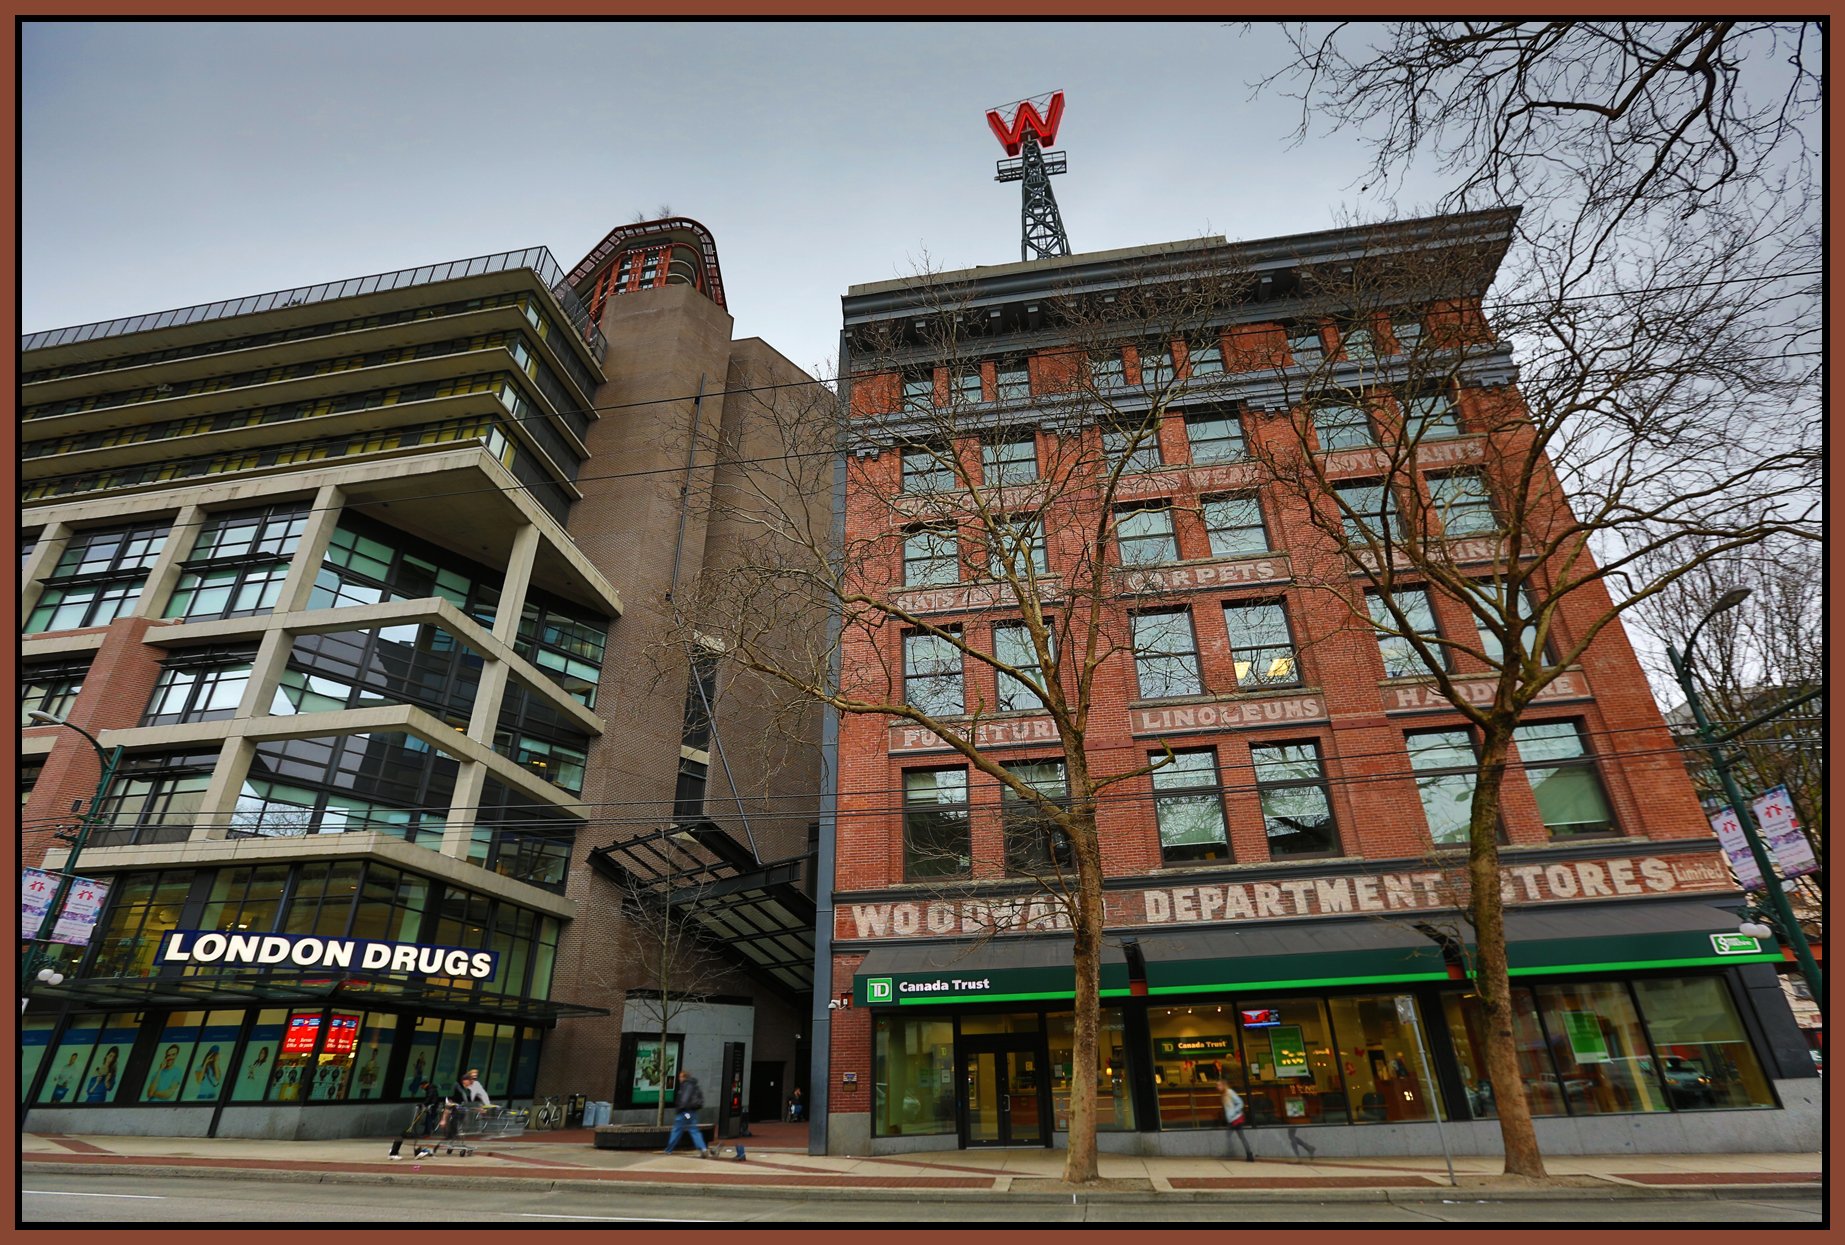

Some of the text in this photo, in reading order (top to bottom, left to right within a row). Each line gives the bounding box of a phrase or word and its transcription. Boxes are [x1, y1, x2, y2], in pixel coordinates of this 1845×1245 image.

[985, 90, 1065, 157] W
[1128, 562, 1275, 593] CARPETS
[1395, 676, 1574, 707] HARDRE
[1142, 699, 1320, 729] LINOLEUMS
[852, 893, 1107, 938] WOODWAR
[1144, 873, 1443, 923] DEPARTMENT
[1671, 860, 1726, 881] Limited
[163, 933, 492, 978] LONDON DRUGS
[870, 978, 990, 998] TD Canada Trust
